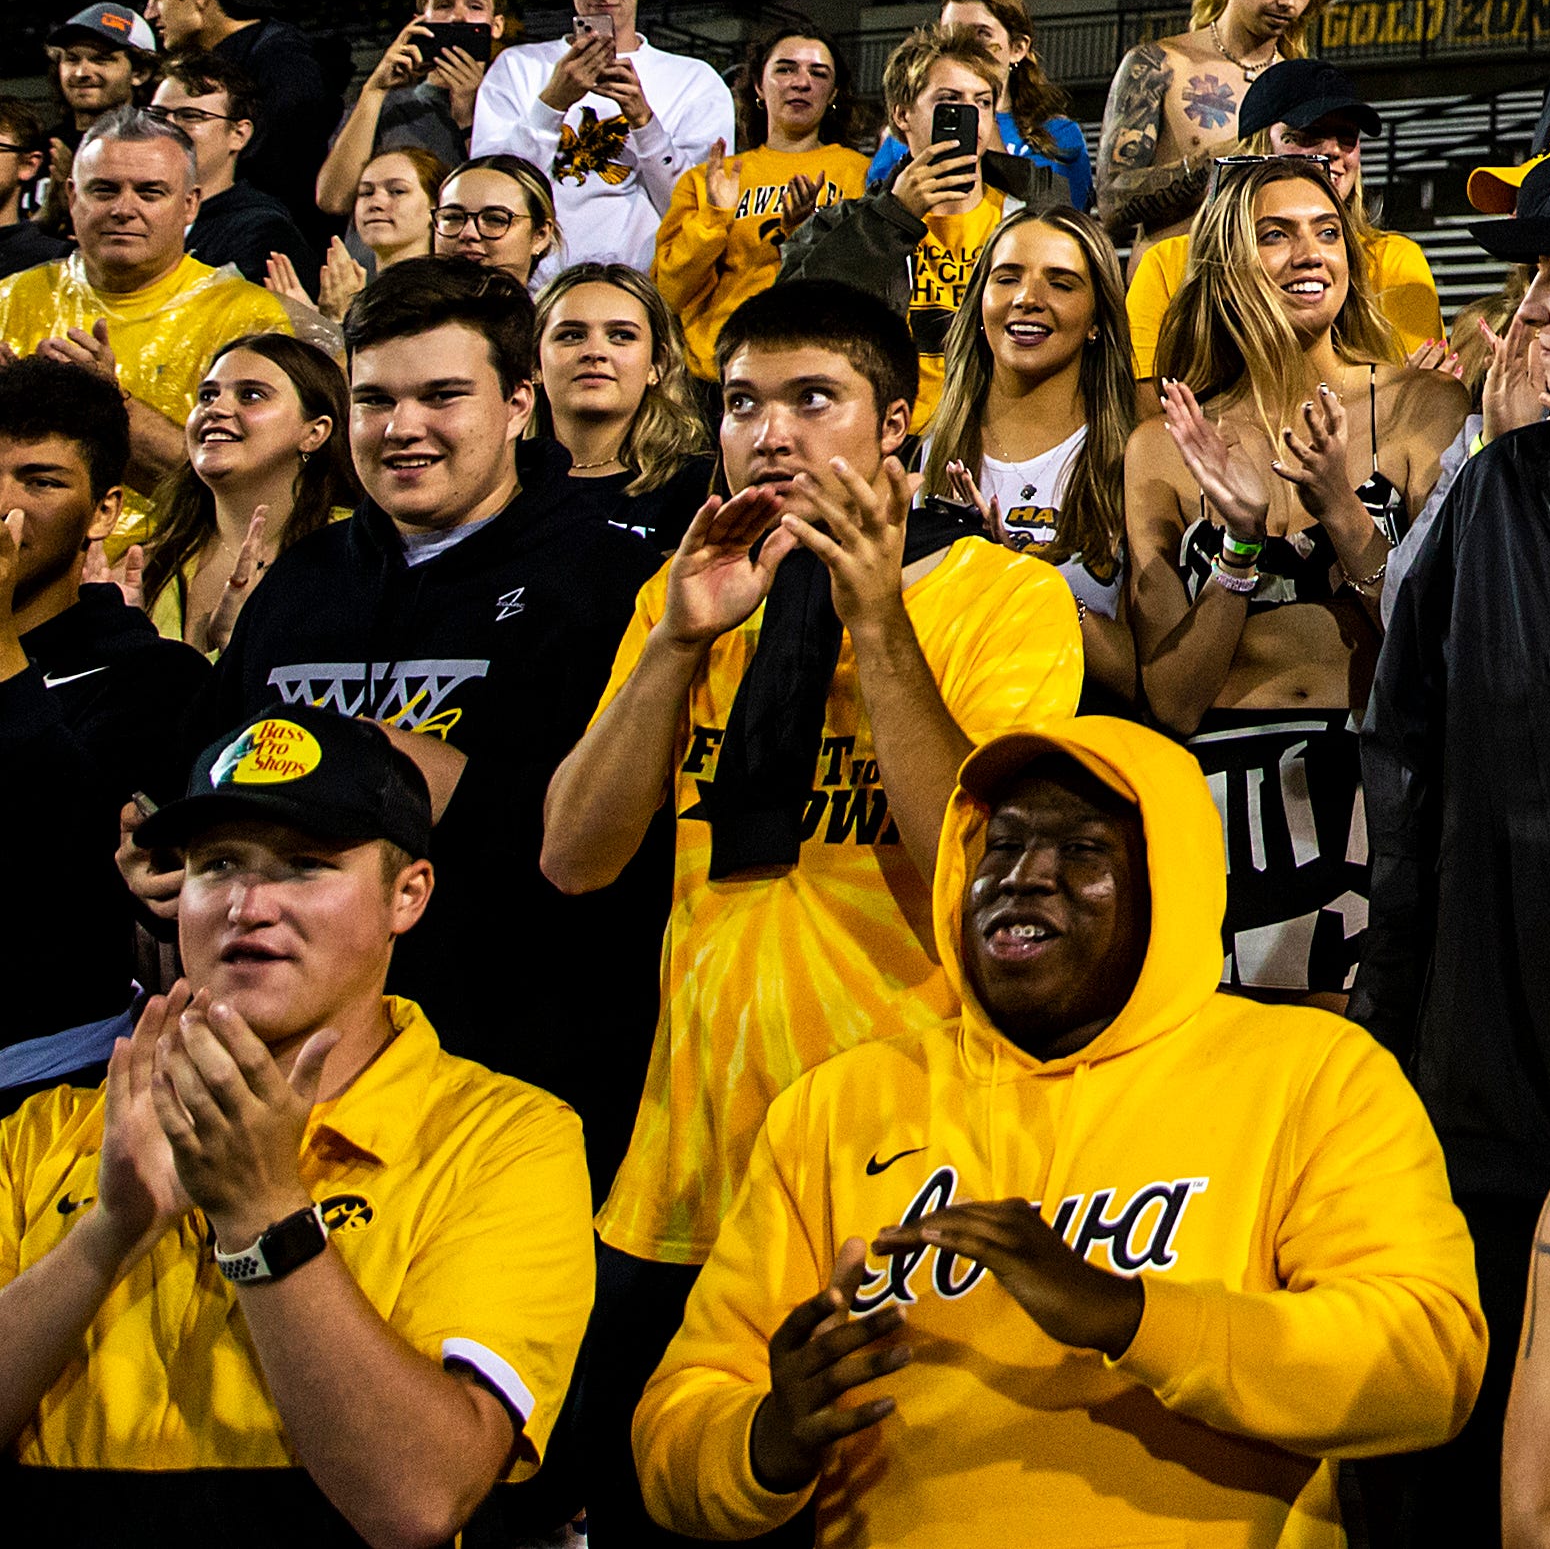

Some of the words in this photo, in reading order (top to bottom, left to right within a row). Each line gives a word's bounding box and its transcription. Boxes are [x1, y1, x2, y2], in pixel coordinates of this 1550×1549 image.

[258, 721, 306, 743] Bass
[254, 740, 290, 757] Pro
[250, 755, 308, 777] Shops
